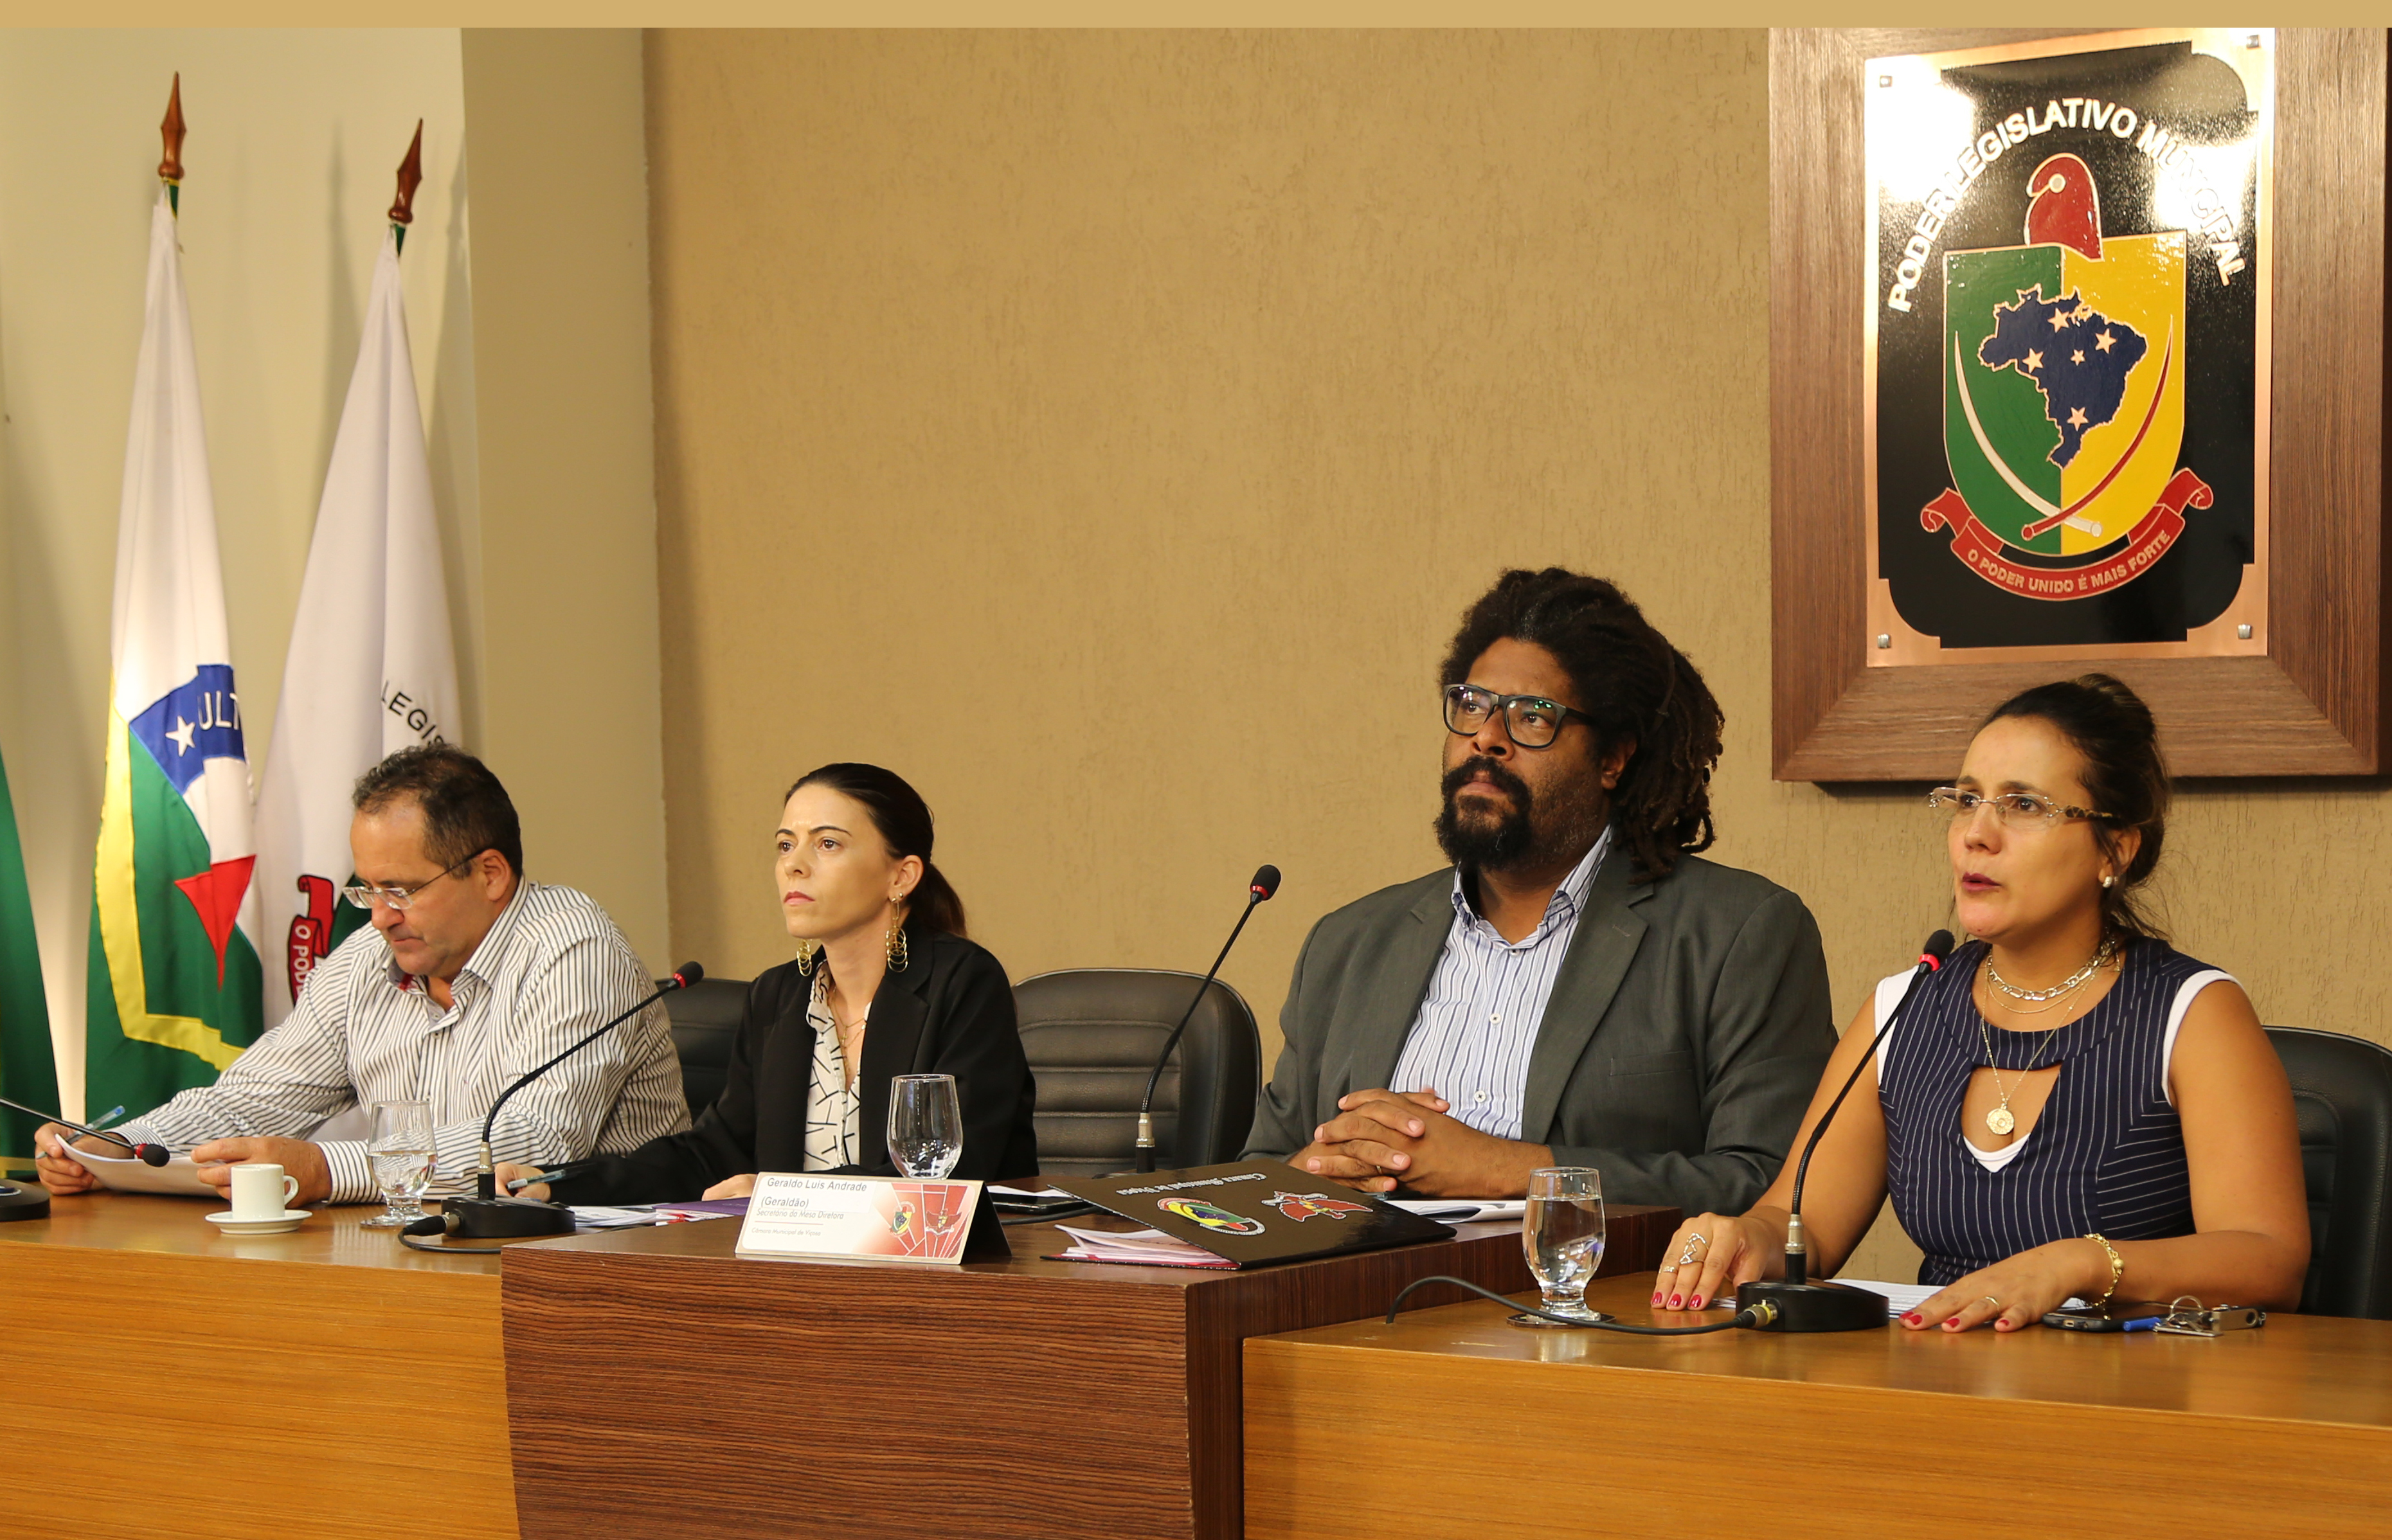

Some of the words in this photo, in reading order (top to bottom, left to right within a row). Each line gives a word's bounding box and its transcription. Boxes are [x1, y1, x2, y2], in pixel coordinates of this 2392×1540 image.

[1888, 188, 1957, 312] PODER
[1945, 97, 2137, 195] LEGISLATIVO
[2136, 120, 2247, 287] MUNCIPAL
[1968, 548, 1979, 562] O
[1980, 557, 2024, 589] PODER
[2028, 577, 2074, 593] UNIDO
[2078, 573, 2088, 591] É
[2091, 564, 2127, 588] MAIS
[2128, 530, 2171, 571] FORTE
[295, 924, 312, 940] O
[768, 1177, 803, 1188] Geraldo
[805, 1179, 825, 1190] Luis
[827, 1181, 867, 1192] Andrade
[760, 1196, 809, 1209] (Geraldão)
[798, 1210, 816, 1219] Mesa
[818, 1211, 844, 1220] Diretora
